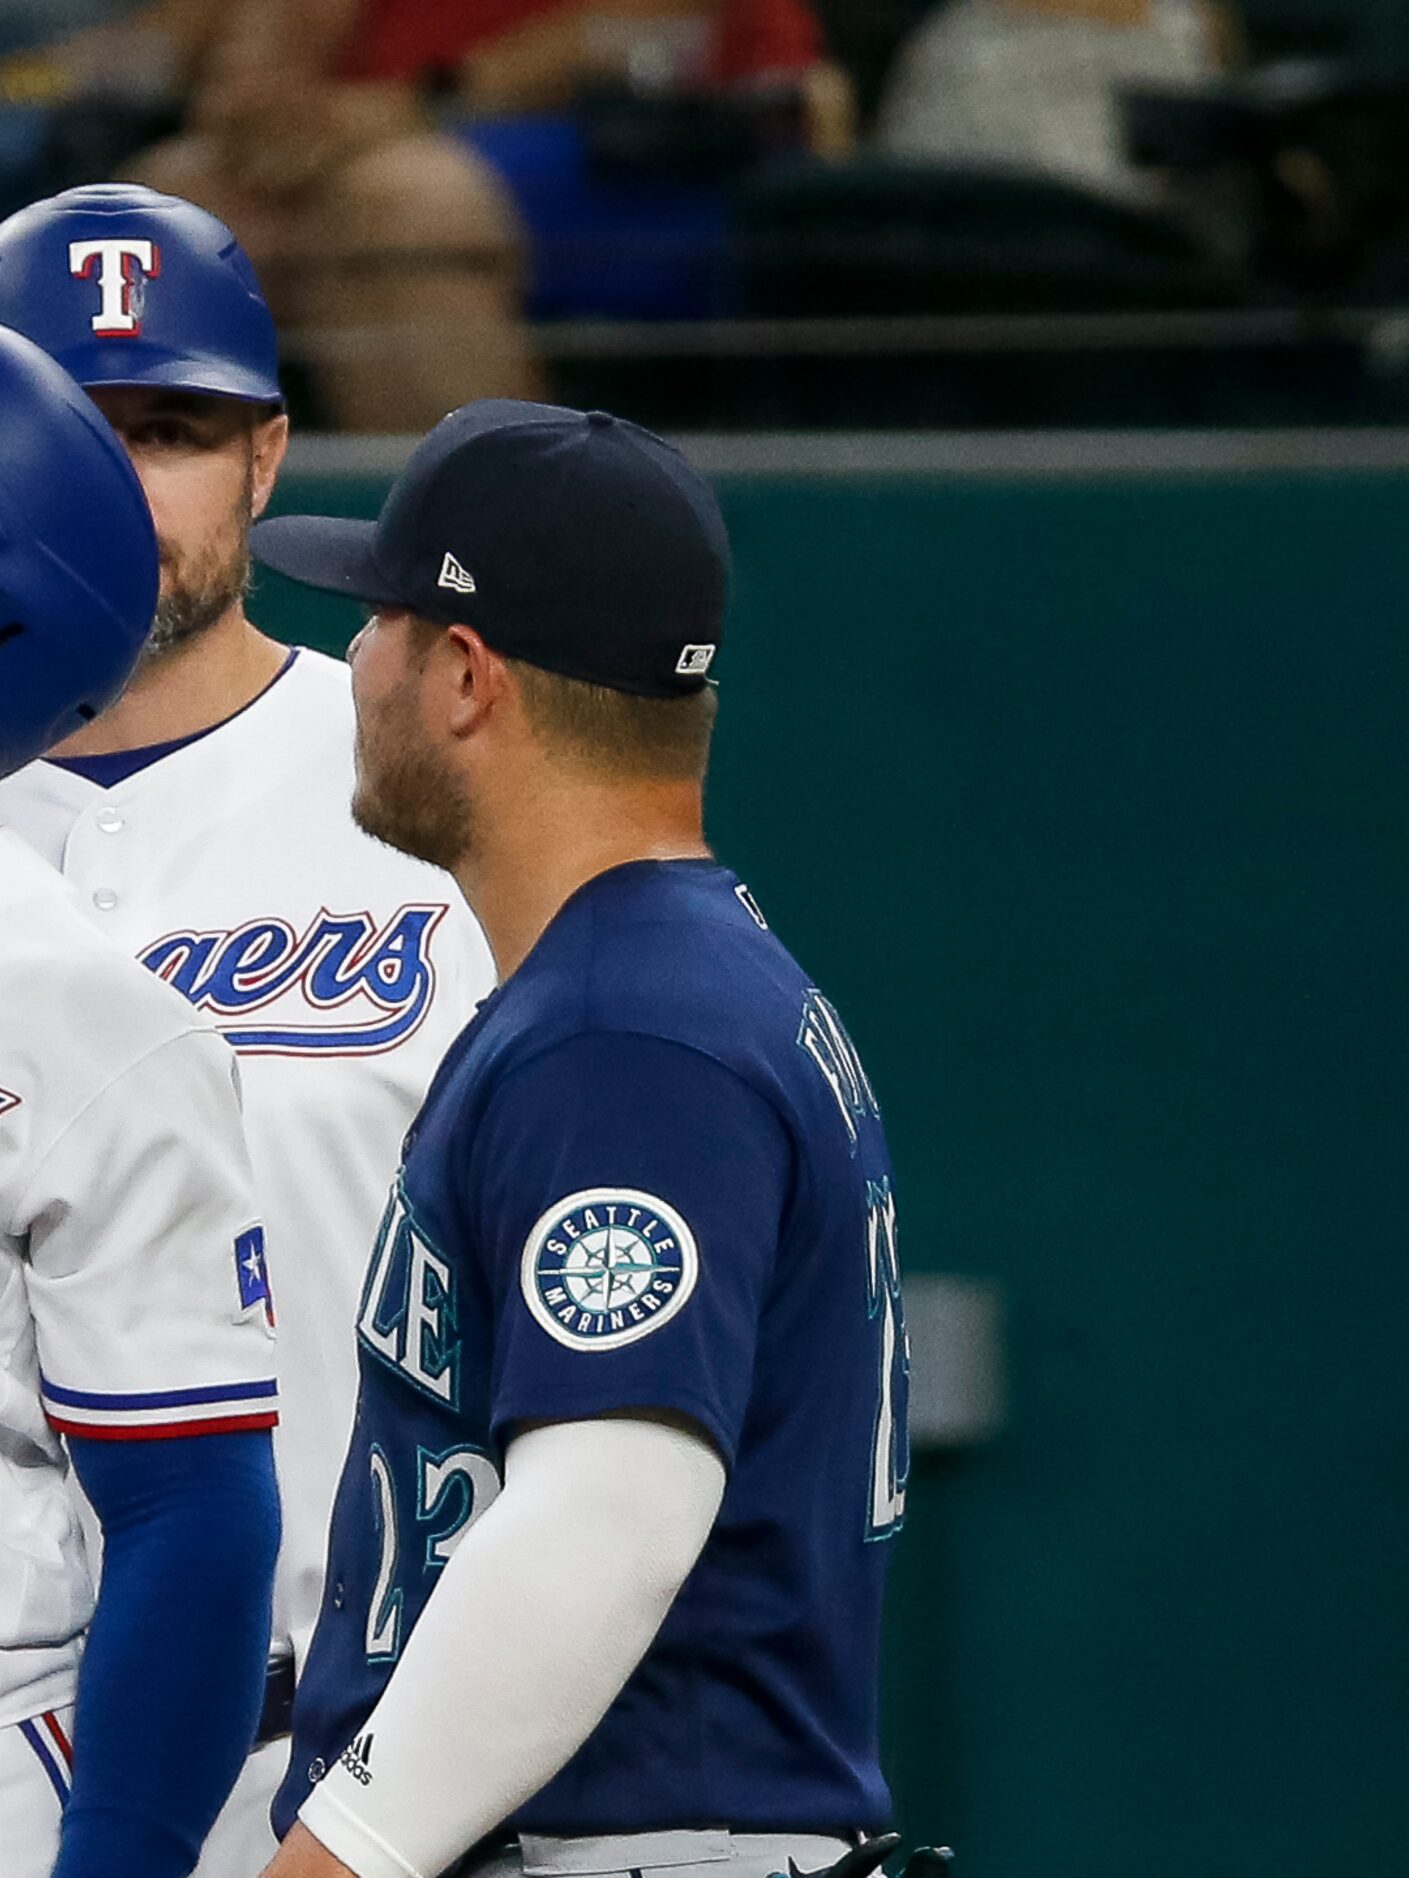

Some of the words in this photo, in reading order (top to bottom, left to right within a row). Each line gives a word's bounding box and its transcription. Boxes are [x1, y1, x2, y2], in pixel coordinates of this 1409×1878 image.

[69, 239, 160, 338] T
[546, 1206, 675, 1256] SEATTLE
[544, 1279, 674, 1333] MARINERS
